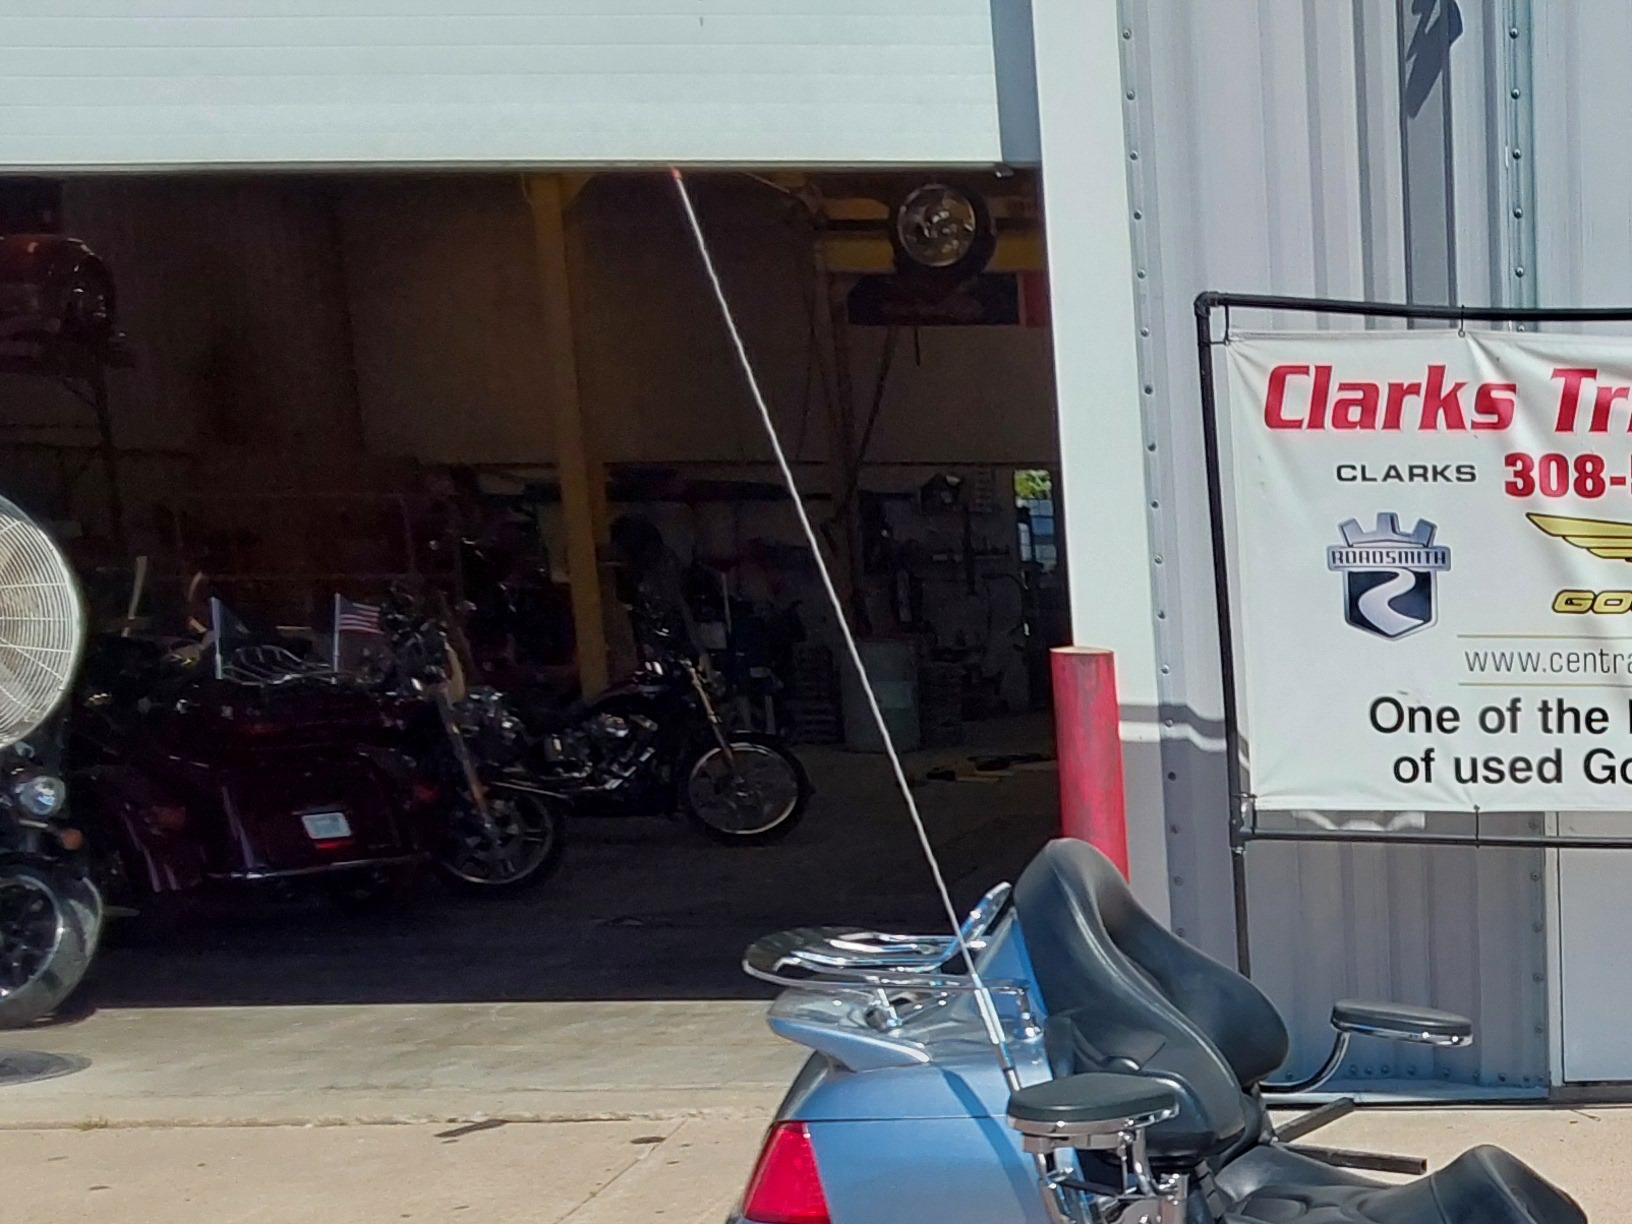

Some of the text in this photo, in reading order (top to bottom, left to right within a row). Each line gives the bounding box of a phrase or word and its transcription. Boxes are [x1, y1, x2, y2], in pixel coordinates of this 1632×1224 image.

[1264, 364, 1517, 431] Clarks
[1336, 464, 1477, 483] CLARKS
[1331, 550, 1447, 565] ROADSMITH
[1369, 696, 1461, 734] One
[1478, 697, 1522, 735] of
[1537, 697, 1610, 735] the
[1393, 748, 1435, 784] of
[1453, 748, 1564, 785] used
